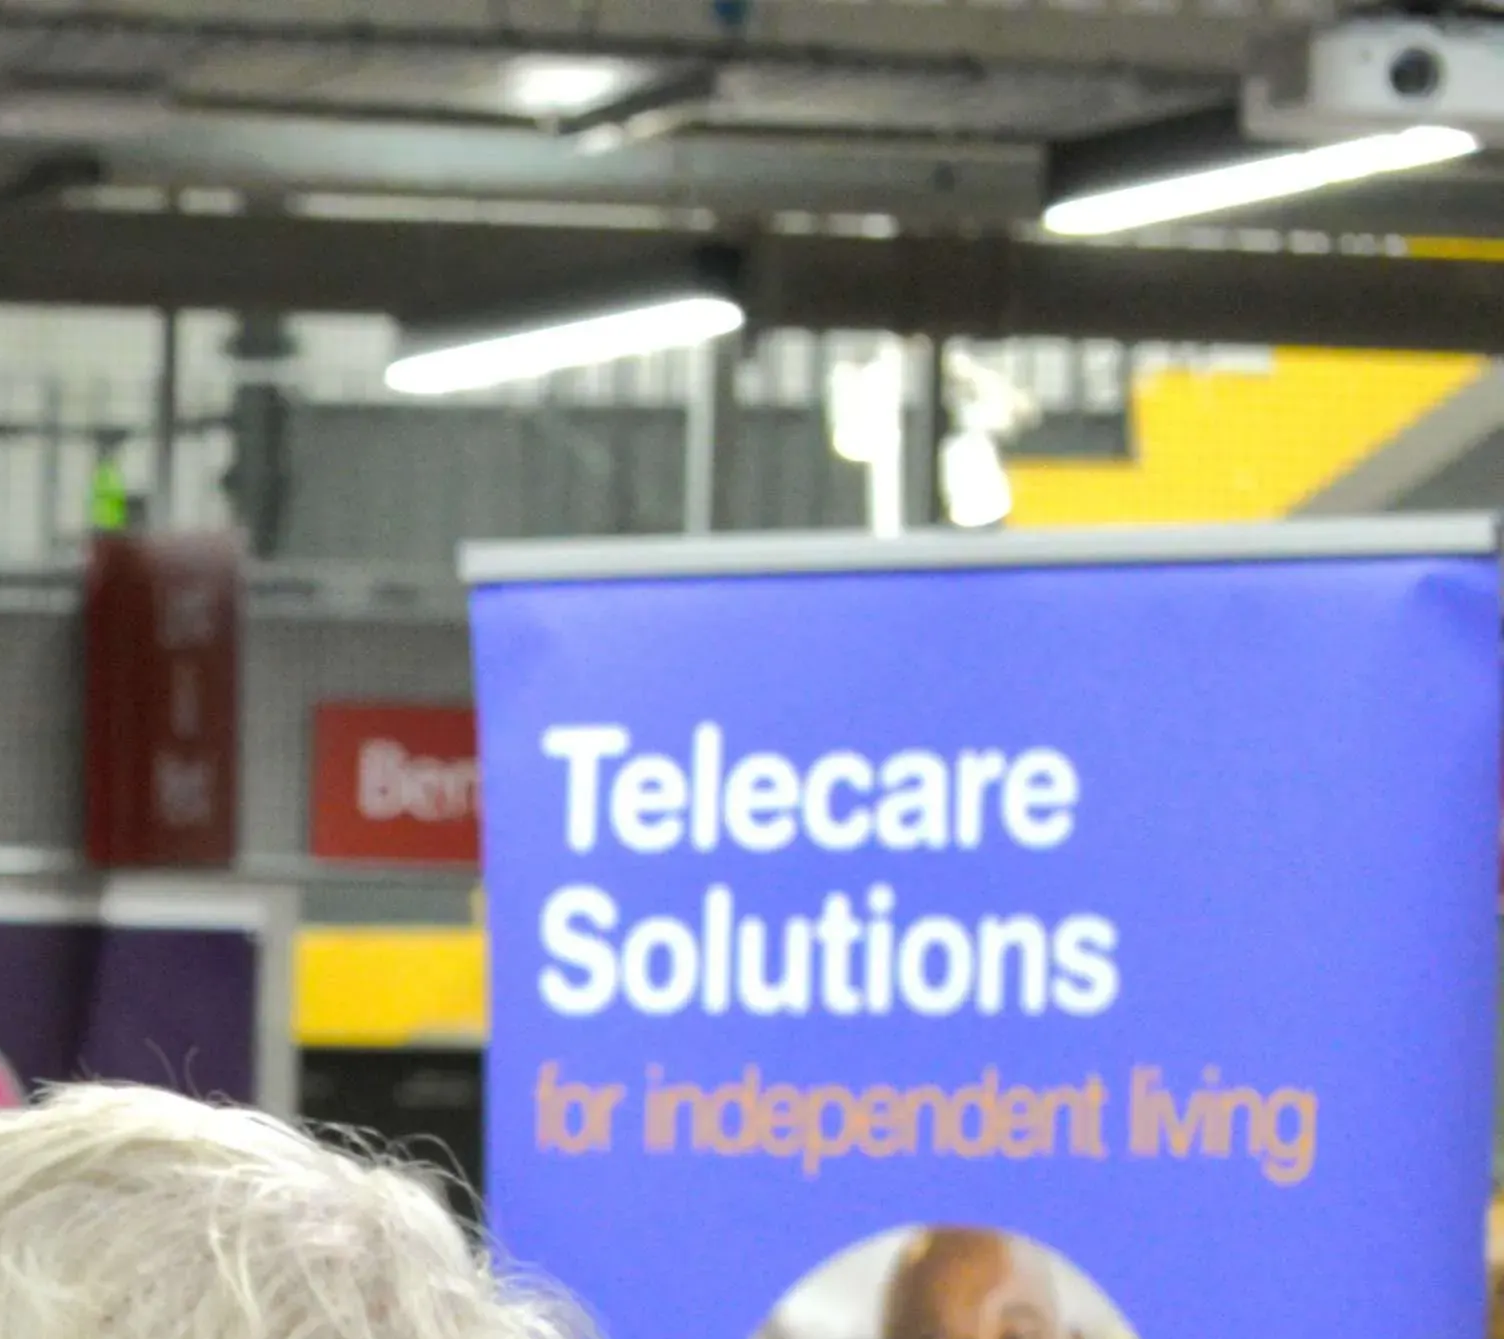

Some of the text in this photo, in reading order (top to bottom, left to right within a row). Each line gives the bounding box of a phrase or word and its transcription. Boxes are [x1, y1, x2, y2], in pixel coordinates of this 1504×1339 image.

[541, 722, 1080, 852] Telecare
[538, 884, 1121, 1016] Solutions
[535, 1062, 1317, 1184] for independent living
